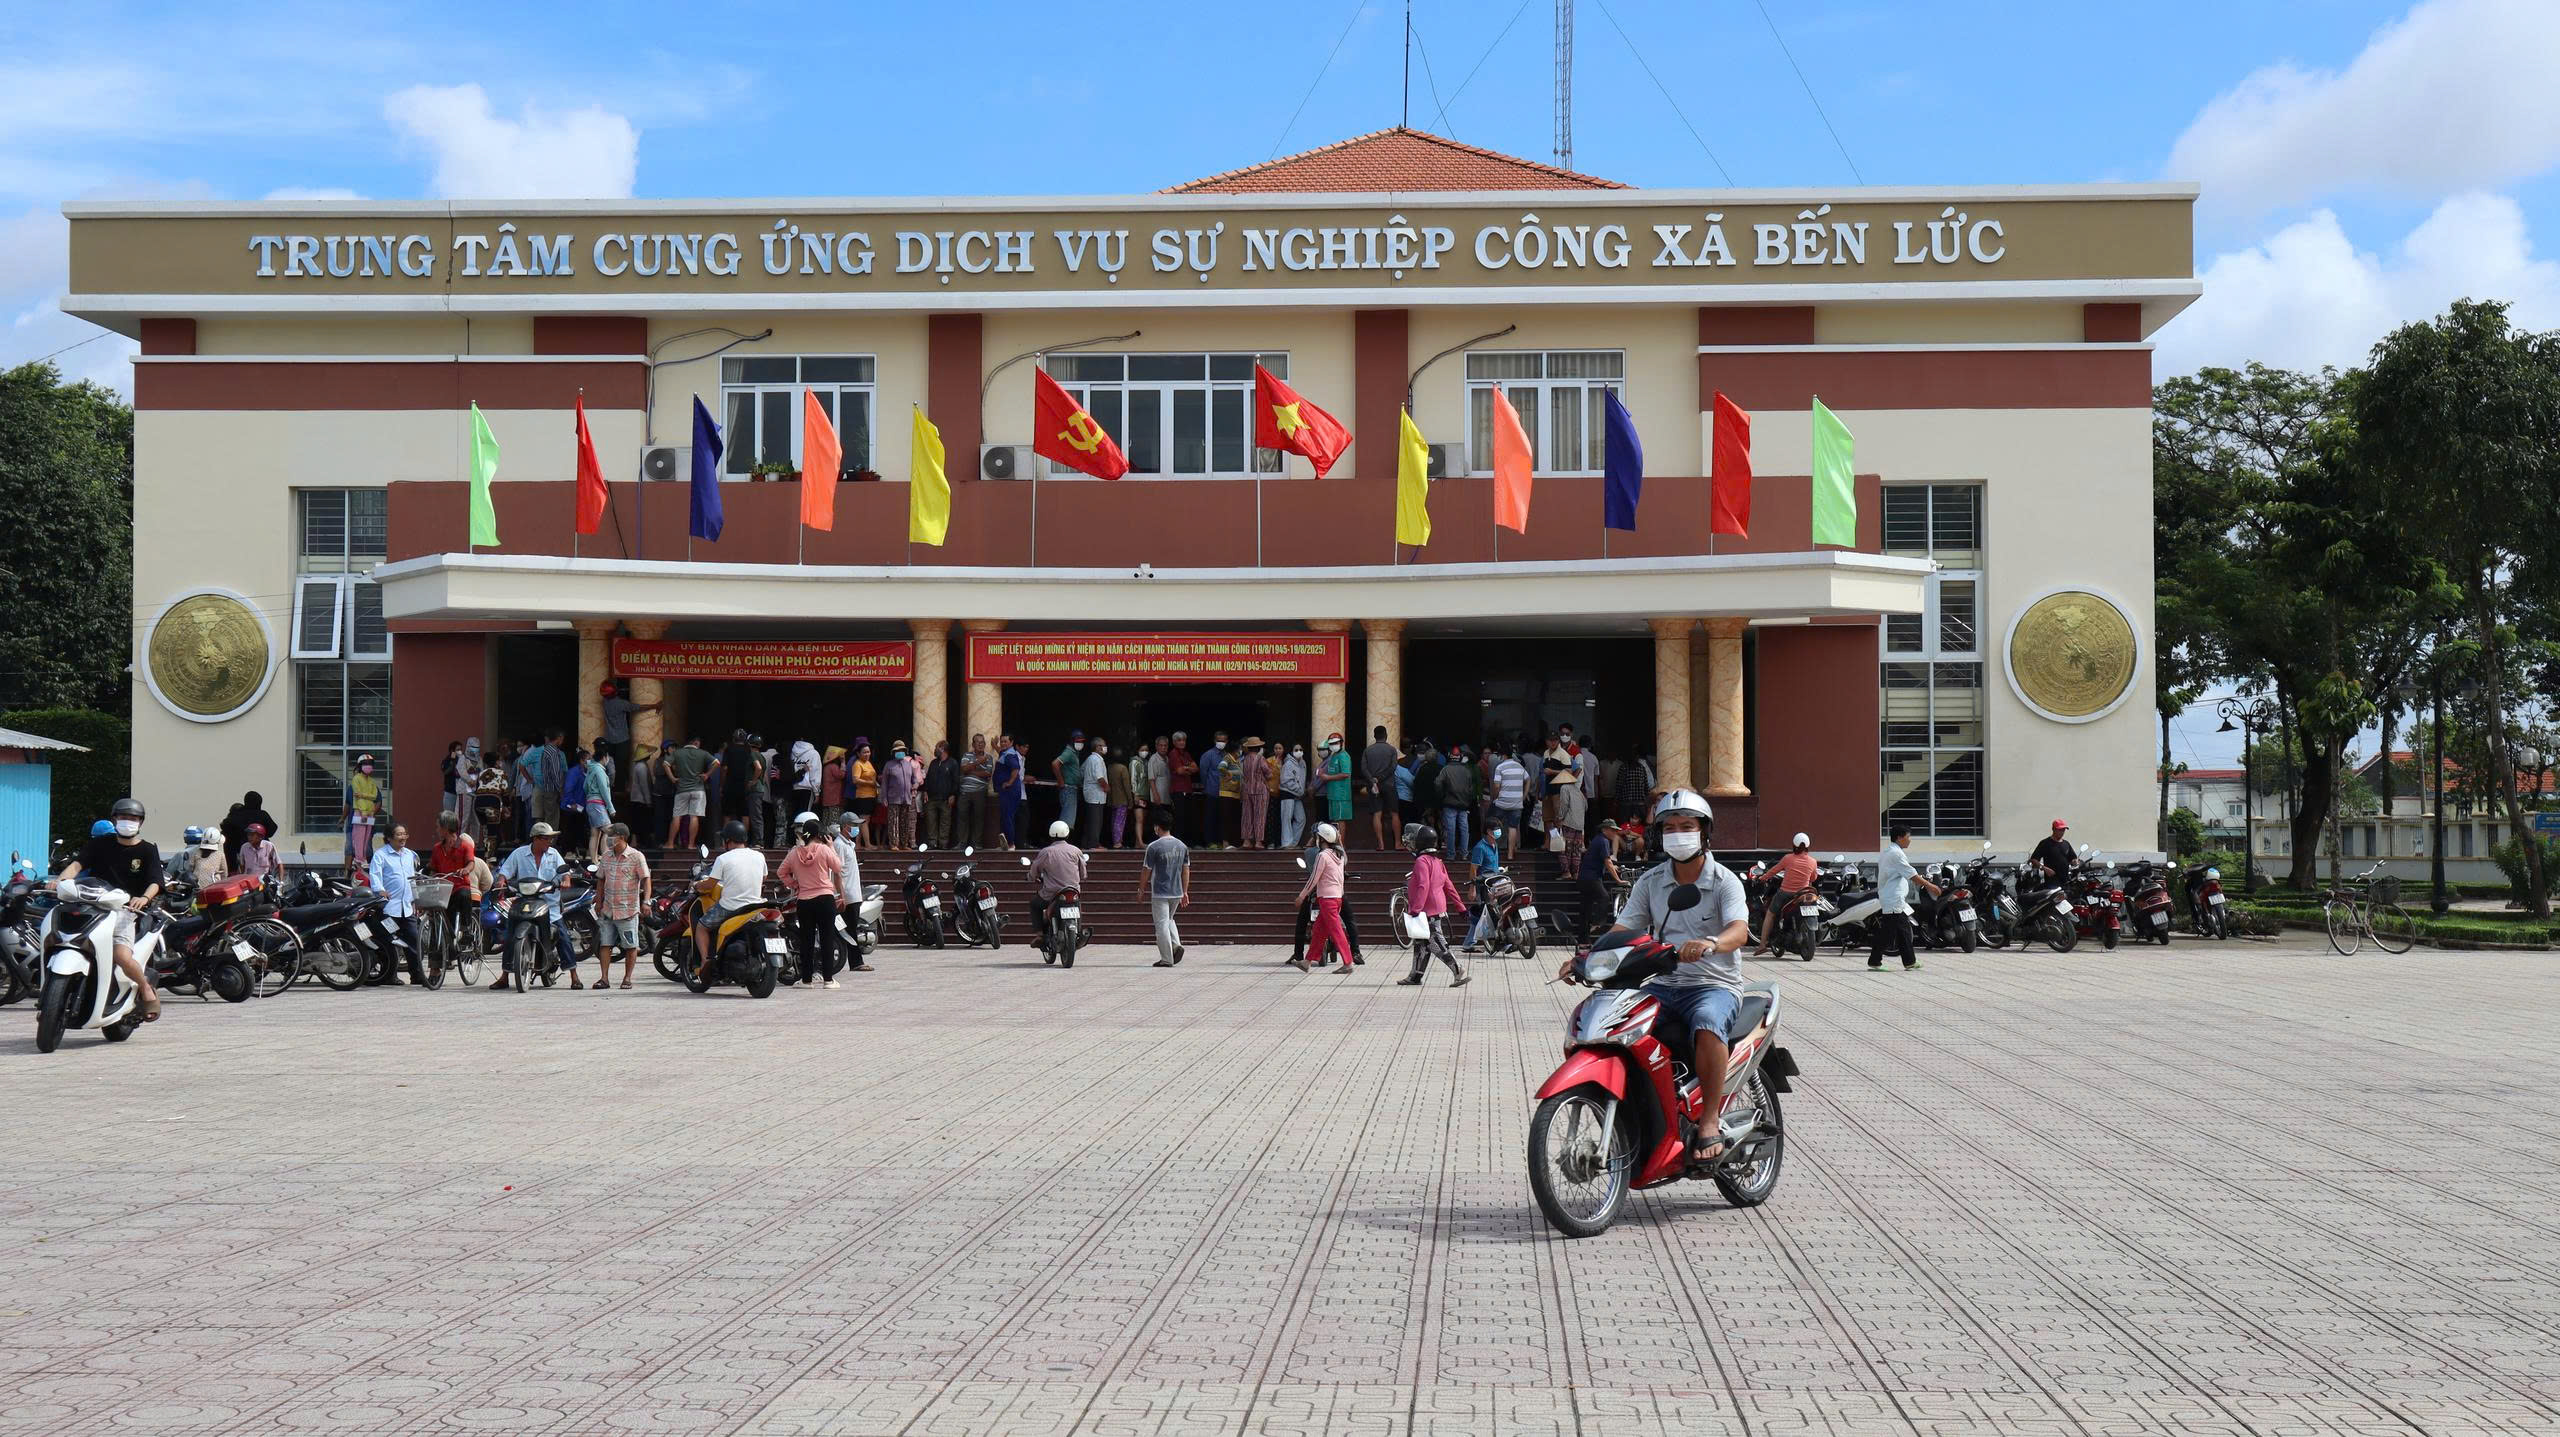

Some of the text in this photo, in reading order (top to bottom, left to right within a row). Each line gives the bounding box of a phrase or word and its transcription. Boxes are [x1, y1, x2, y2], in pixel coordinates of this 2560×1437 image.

[248, 204, 2006, 285] TRUNG TÂM CUNG ỨNG DỊCH VỤ SỰ NGHIỆP CÔNG XÃ BẾN LỨC
[988, 643, 1008, 656] NHIỆT
[1009, 643, 1023, 656] LIỆT
[1024, 642, 1042, 654] CHÀO
[1044, 642, 1065, 654] MỪNG
[1077, 643, 1096, 656] NIỆM
[1096, 645, 1106, 654] 80
[1107, 643, 1123, 654] NĂM
[1124, 642, 1143, 654] CÁCH
[1144, 644, 1165, 656] MẠNG
[1167, 642, 1189, 654] THÁNG
[1191, 642, 1206, 654] TÁM
[1208, 642, 1230, 654] THÀNH
[1232, 642, 1250, 654] CÔNG
[621, 650, 904, 666] ĐIỂM TẶNG QUÀ CỦA CHÍNH PHỦ CHO NHÂN DÂN
[1016, 660, 1025, 671] VÀ
[1026, 658, 1045, 672] QUỐC
[1046, 659, 1070, 671] KHÁNH
[1072, 659, 1090, 671] NƯỚC
[1092, 660, 1110, 673] CỘNG
[1127, 660, 1137, 671] XÃ
[1138, 660, 1150, 673] HỘI
[1152, 658, 1166, 671] CHỦ
[1167, 658, 1188, 671] NGHĨA
[1190, 659, 1204, 672] VIỆT
[1206, 661, 1222, 671] NAM
